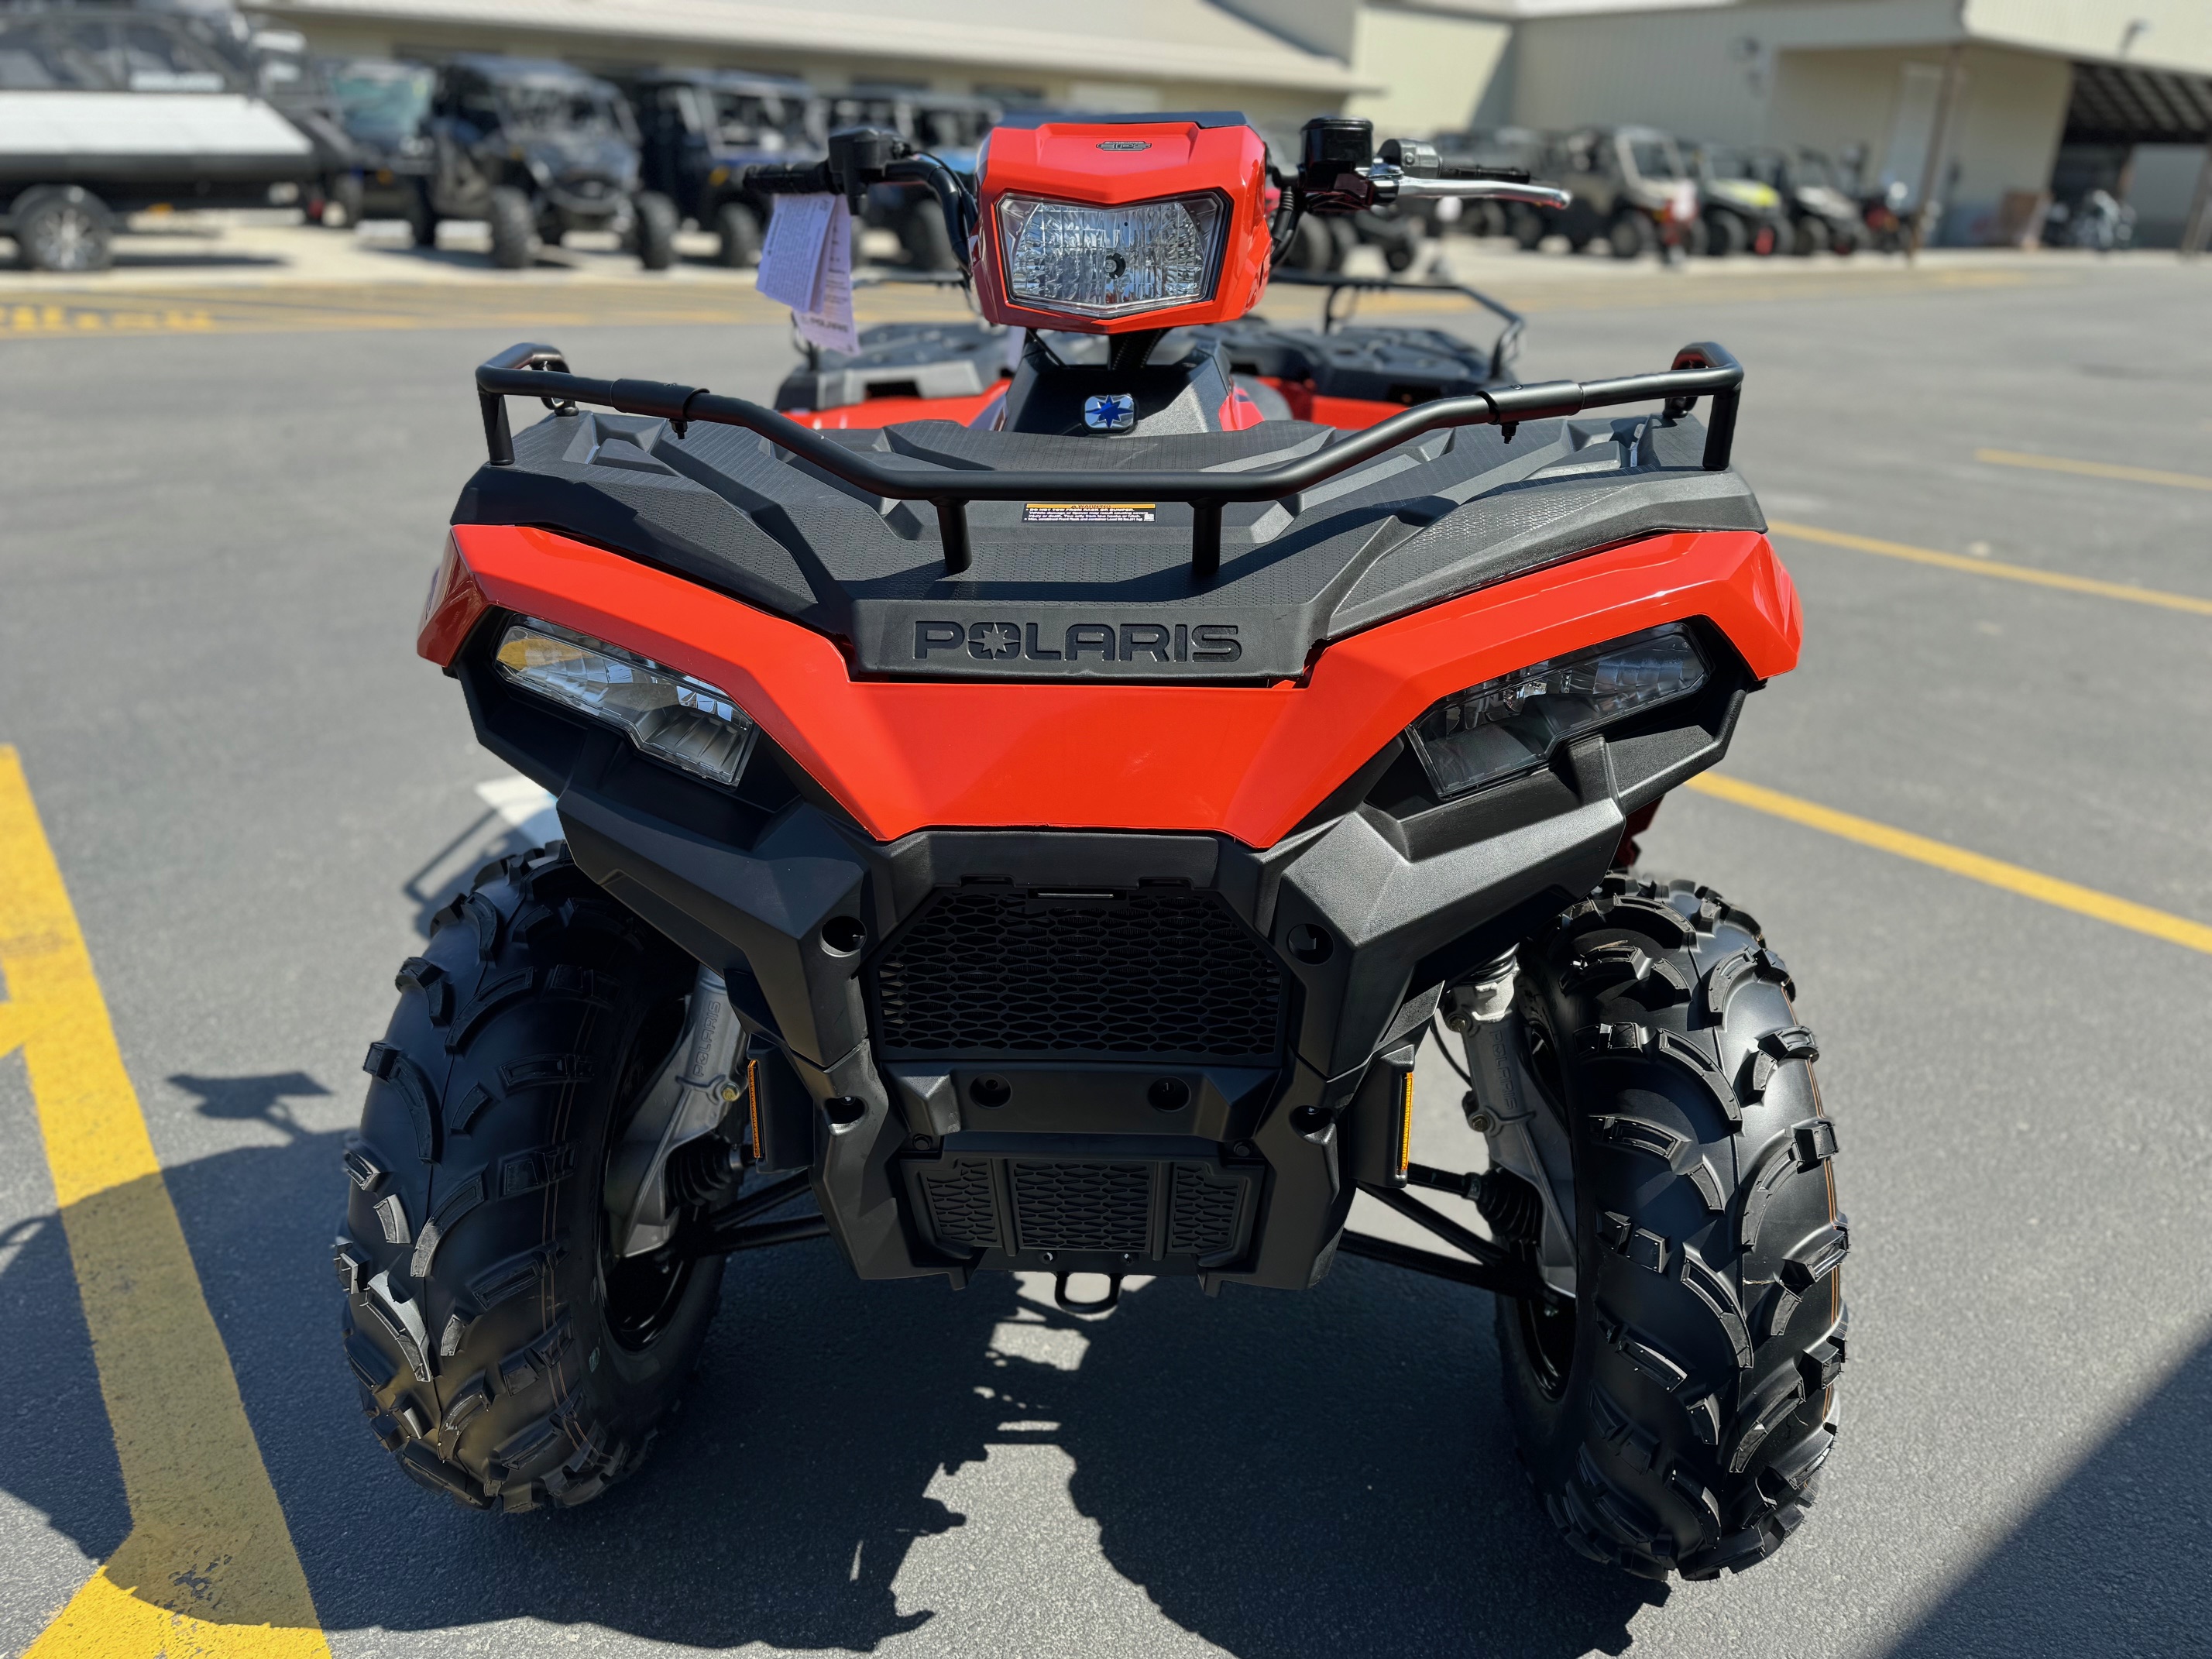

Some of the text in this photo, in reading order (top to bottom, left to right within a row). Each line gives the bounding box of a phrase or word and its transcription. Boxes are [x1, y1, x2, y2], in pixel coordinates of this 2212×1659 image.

[913, 620, 1242, 663] POLARIS
[693, 1000, 721, 1077] POLARIS
[1489, 1029, 1518, 1110] POLARIS
